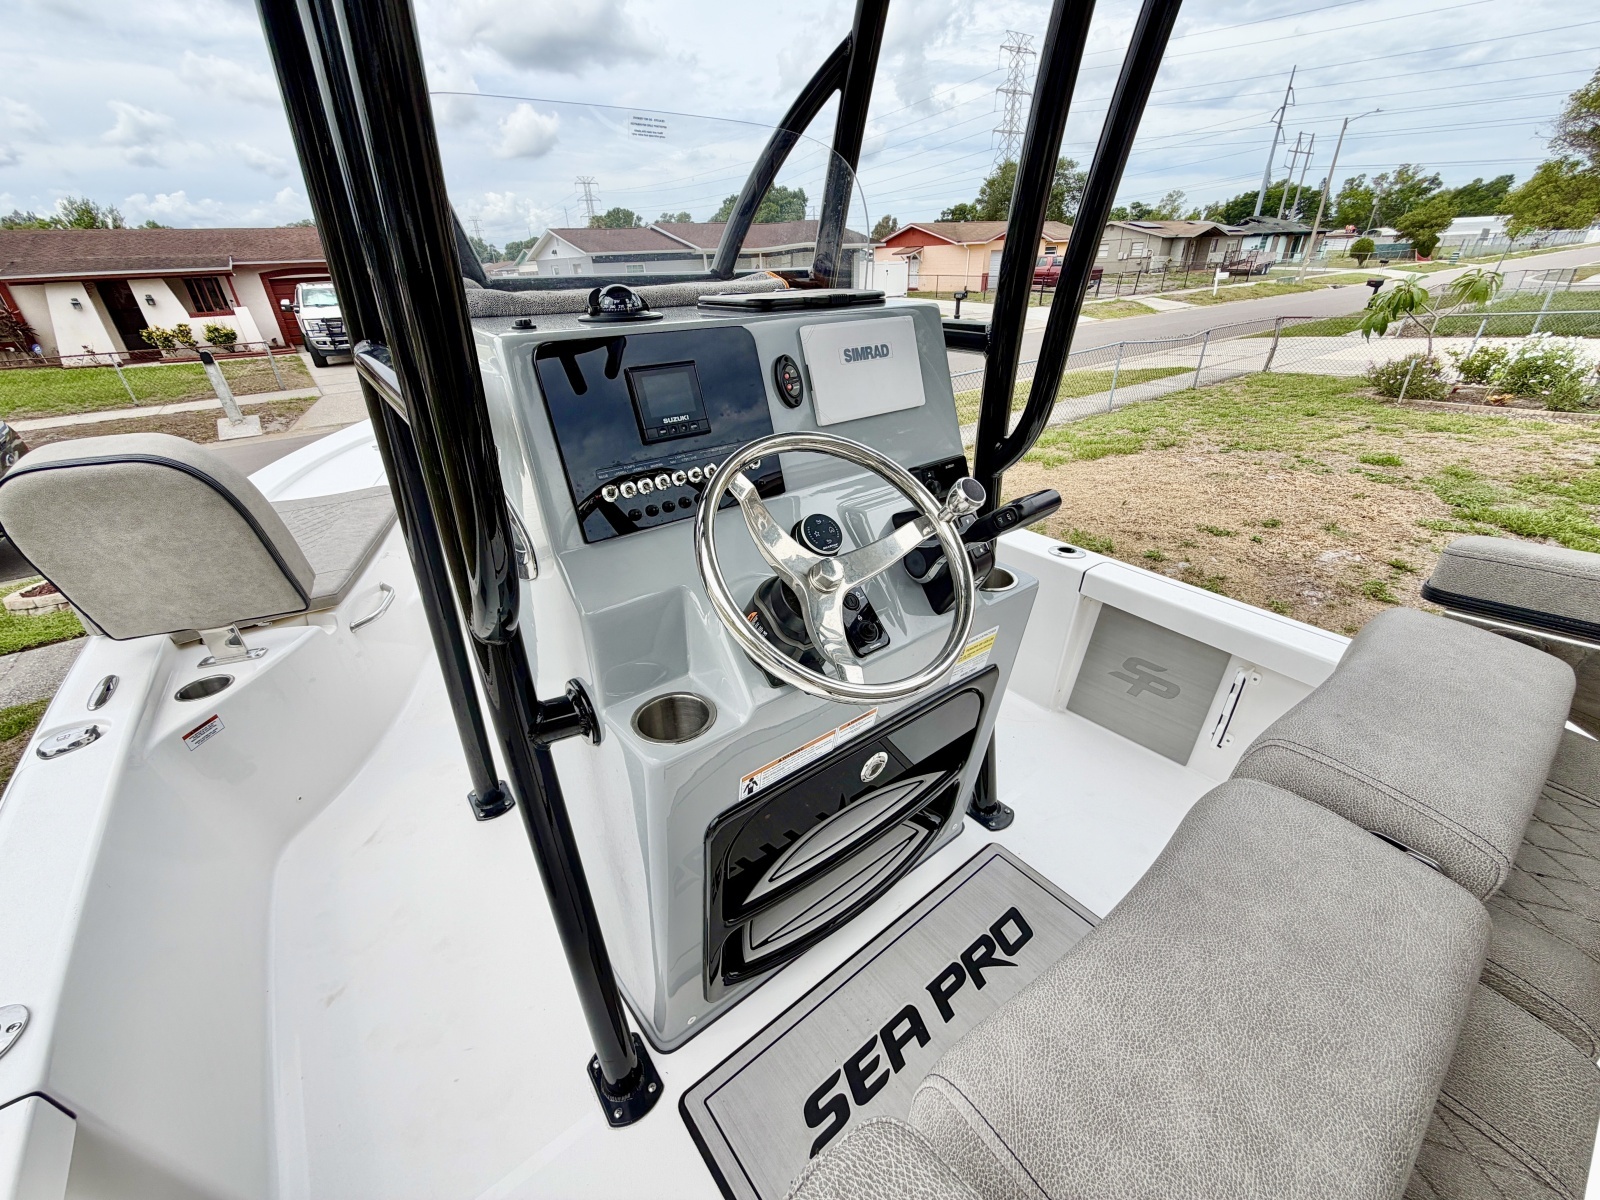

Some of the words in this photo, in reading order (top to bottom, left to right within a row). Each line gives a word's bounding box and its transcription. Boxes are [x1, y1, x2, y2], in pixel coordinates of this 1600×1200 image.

[843, 343, 890, 363] SIMRAD
[662, 414, 690, 424] SUZUKI
[803, 1004, 931, 1160] SEA
[925, 906, 1034, 1023] PRO
